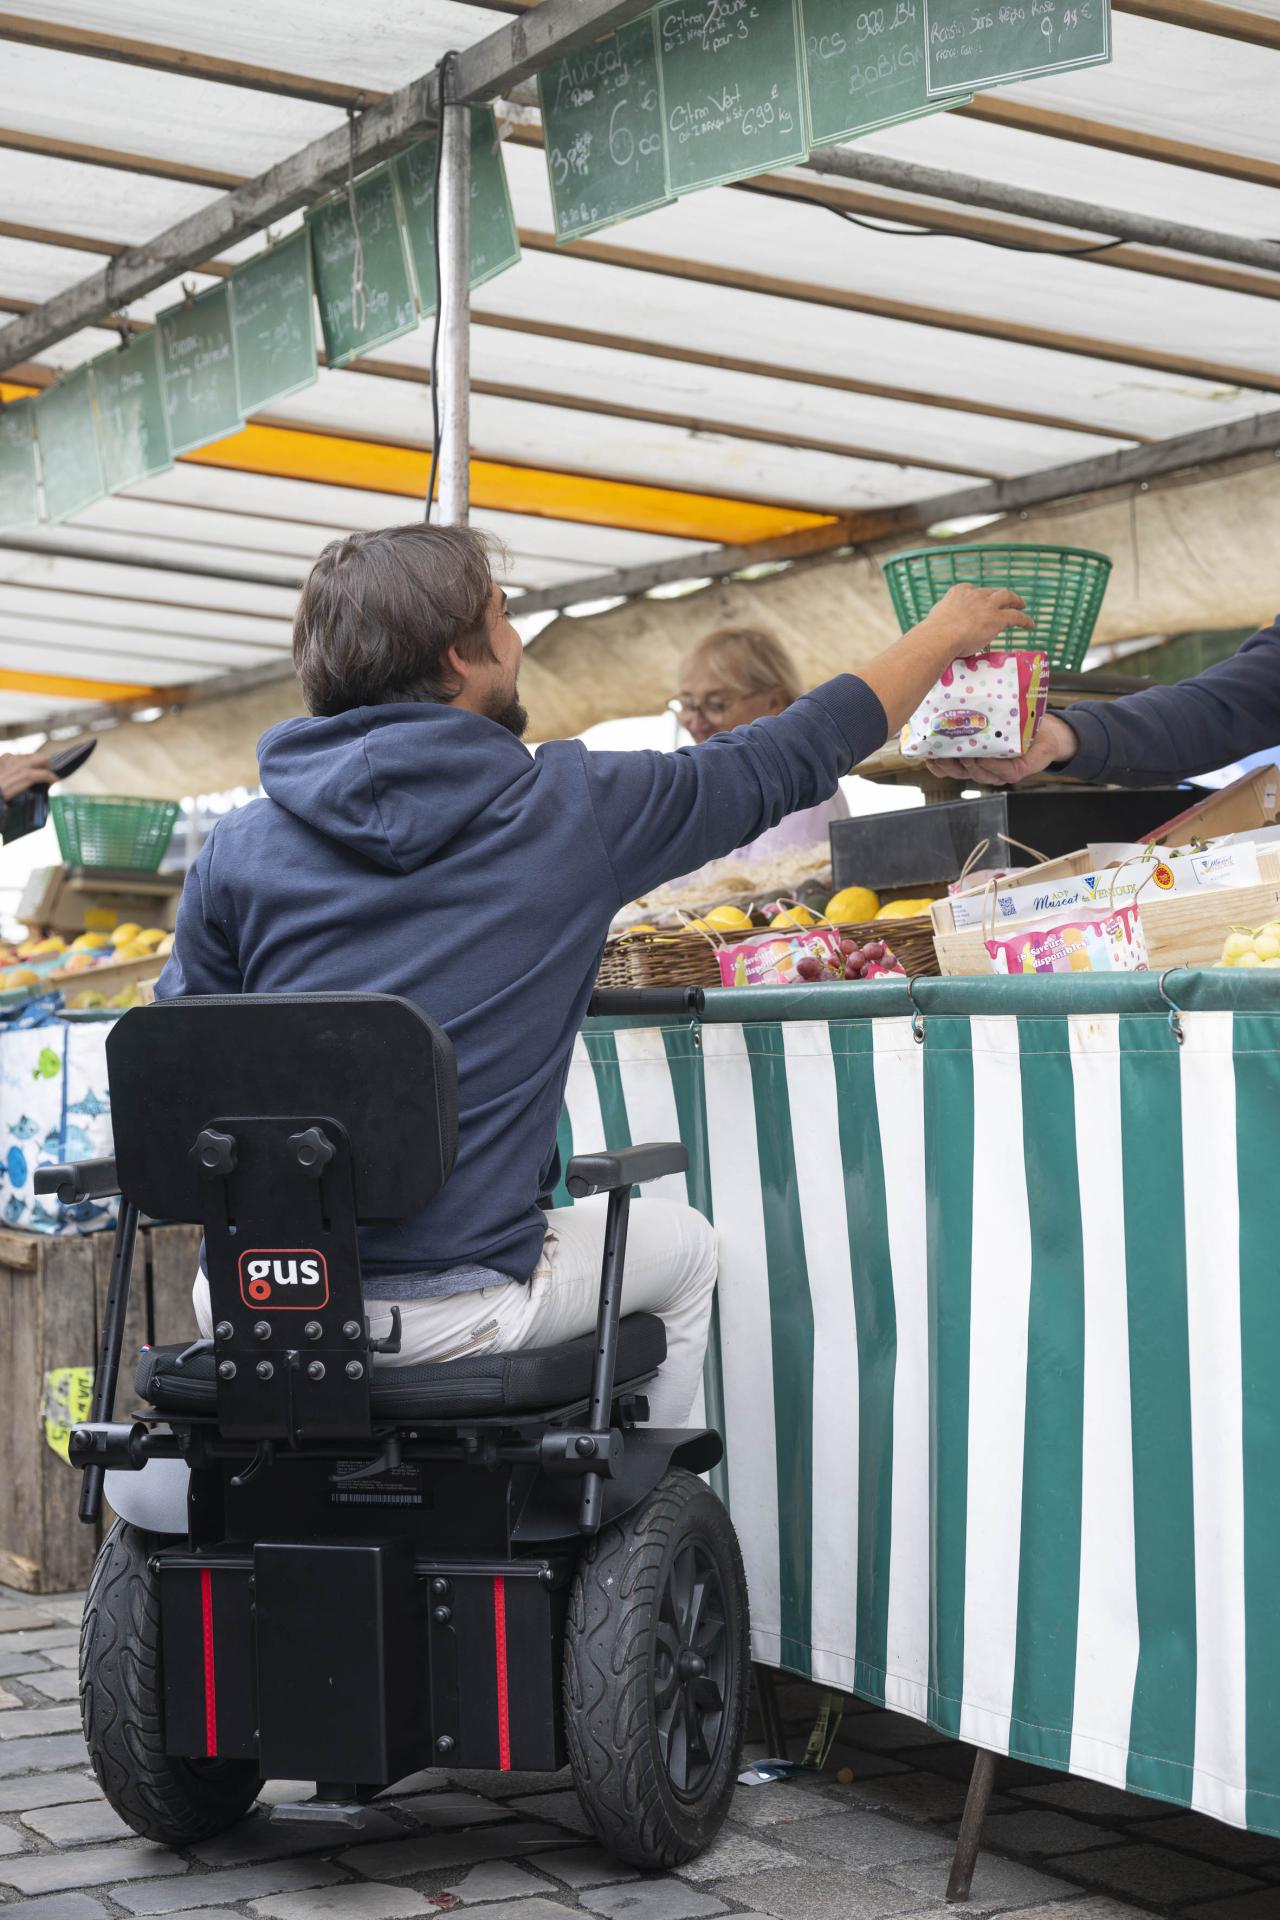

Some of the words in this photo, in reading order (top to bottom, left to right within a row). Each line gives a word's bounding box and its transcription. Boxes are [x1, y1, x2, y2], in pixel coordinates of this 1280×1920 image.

[663, 9, 705, 37] Citron
[713, 34, 734, 53] par
[737, 19, 749, 39] 3
[669, 103, 710, 131] Citron
[707, 83, 741, 112] Vert
[742, 102, 775, 135] 6,99
[778, 107, 794, 134] kg
[1033, 893, 1079, 911] Muscat
[1030, 938, 1064, 957] Saveurs
[247, 1258, 320, 1301] gus
